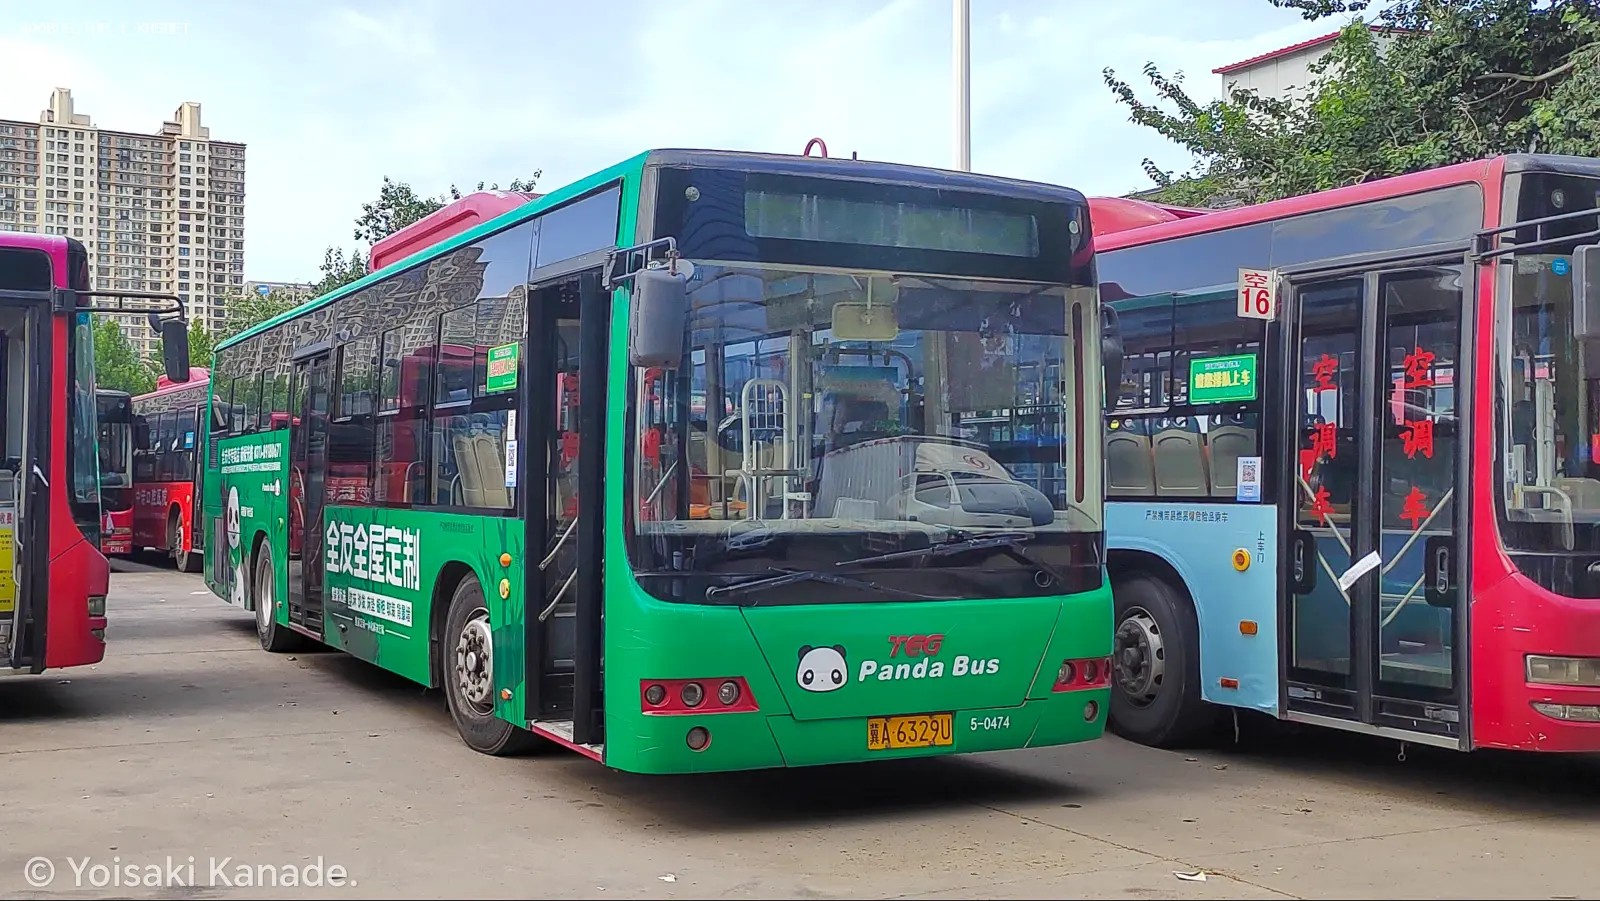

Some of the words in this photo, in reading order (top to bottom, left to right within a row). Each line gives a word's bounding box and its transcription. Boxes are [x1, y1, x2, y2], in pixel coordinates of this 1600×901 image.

[1243, 272, 1269, 290] 空
[1241, 290, 1270, 315] 16
[1309, 353, 1338, 527] 空调车
[1399, 347, 1436, 531] 空调车
[326, 520, 420, 592] 全友全屋定制
[888, 634, 944, 658] TEG
[858, 657, 944, 682] Panda
[952, 655, 1000, 677] Bus
[970, 716, 1010, 731] 5-0474
